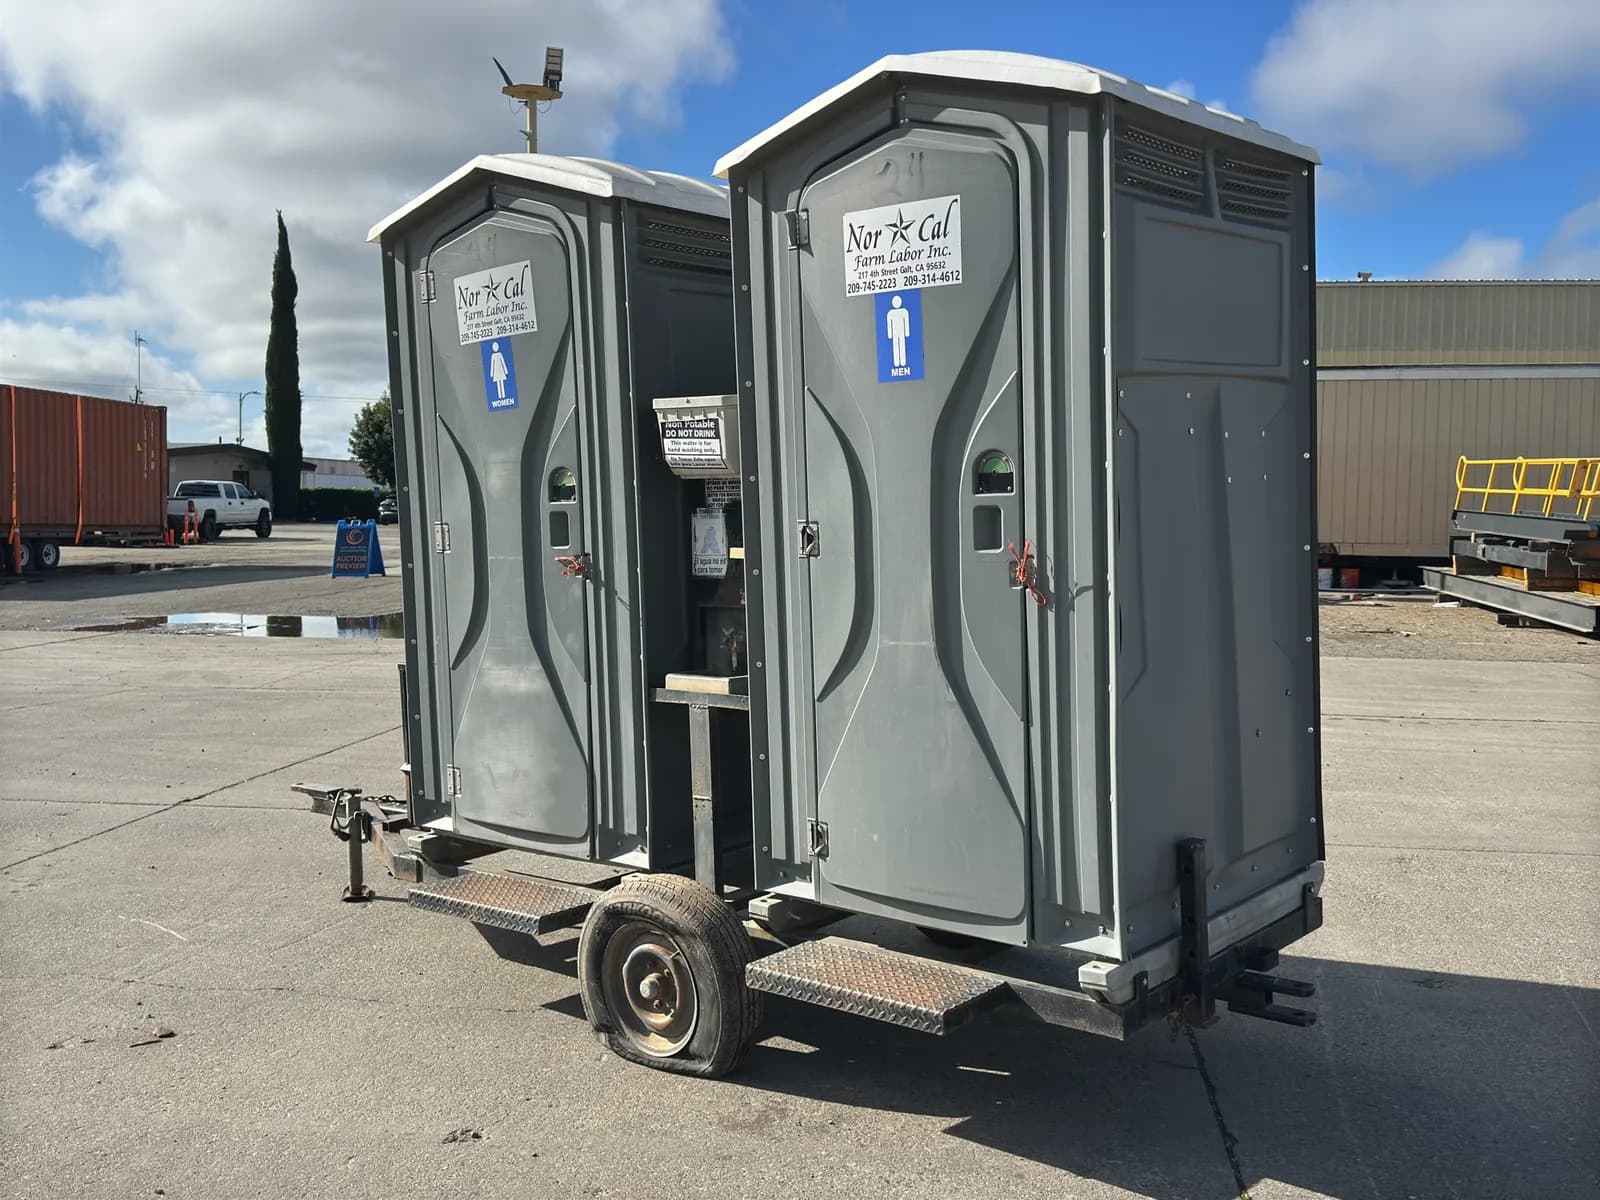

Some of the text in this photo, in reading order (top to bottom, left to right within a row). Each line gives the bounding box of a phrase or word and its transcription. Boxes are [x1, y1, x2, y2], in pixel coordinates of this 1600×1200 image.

[846, 198, 959, 253] Nor Cal
[853, 245, 952, 272] Farm Labor Inc.
[858, 261, 946, 279] 217 4th Street Galt, CA 95632
[458, 264, 529, 310] Nor Cal
[847, 270, 961, 294] 209-745-2223 209-314-4612
[463, 301, 528, 324] Farm Labor Inc.
[891, 367, 911, 377] MEN
[491, 398, 515, 409] WOMEN
[665, 429, 716, 438] DO NOT DRINK
[684, 419, 716, 428] Potable
